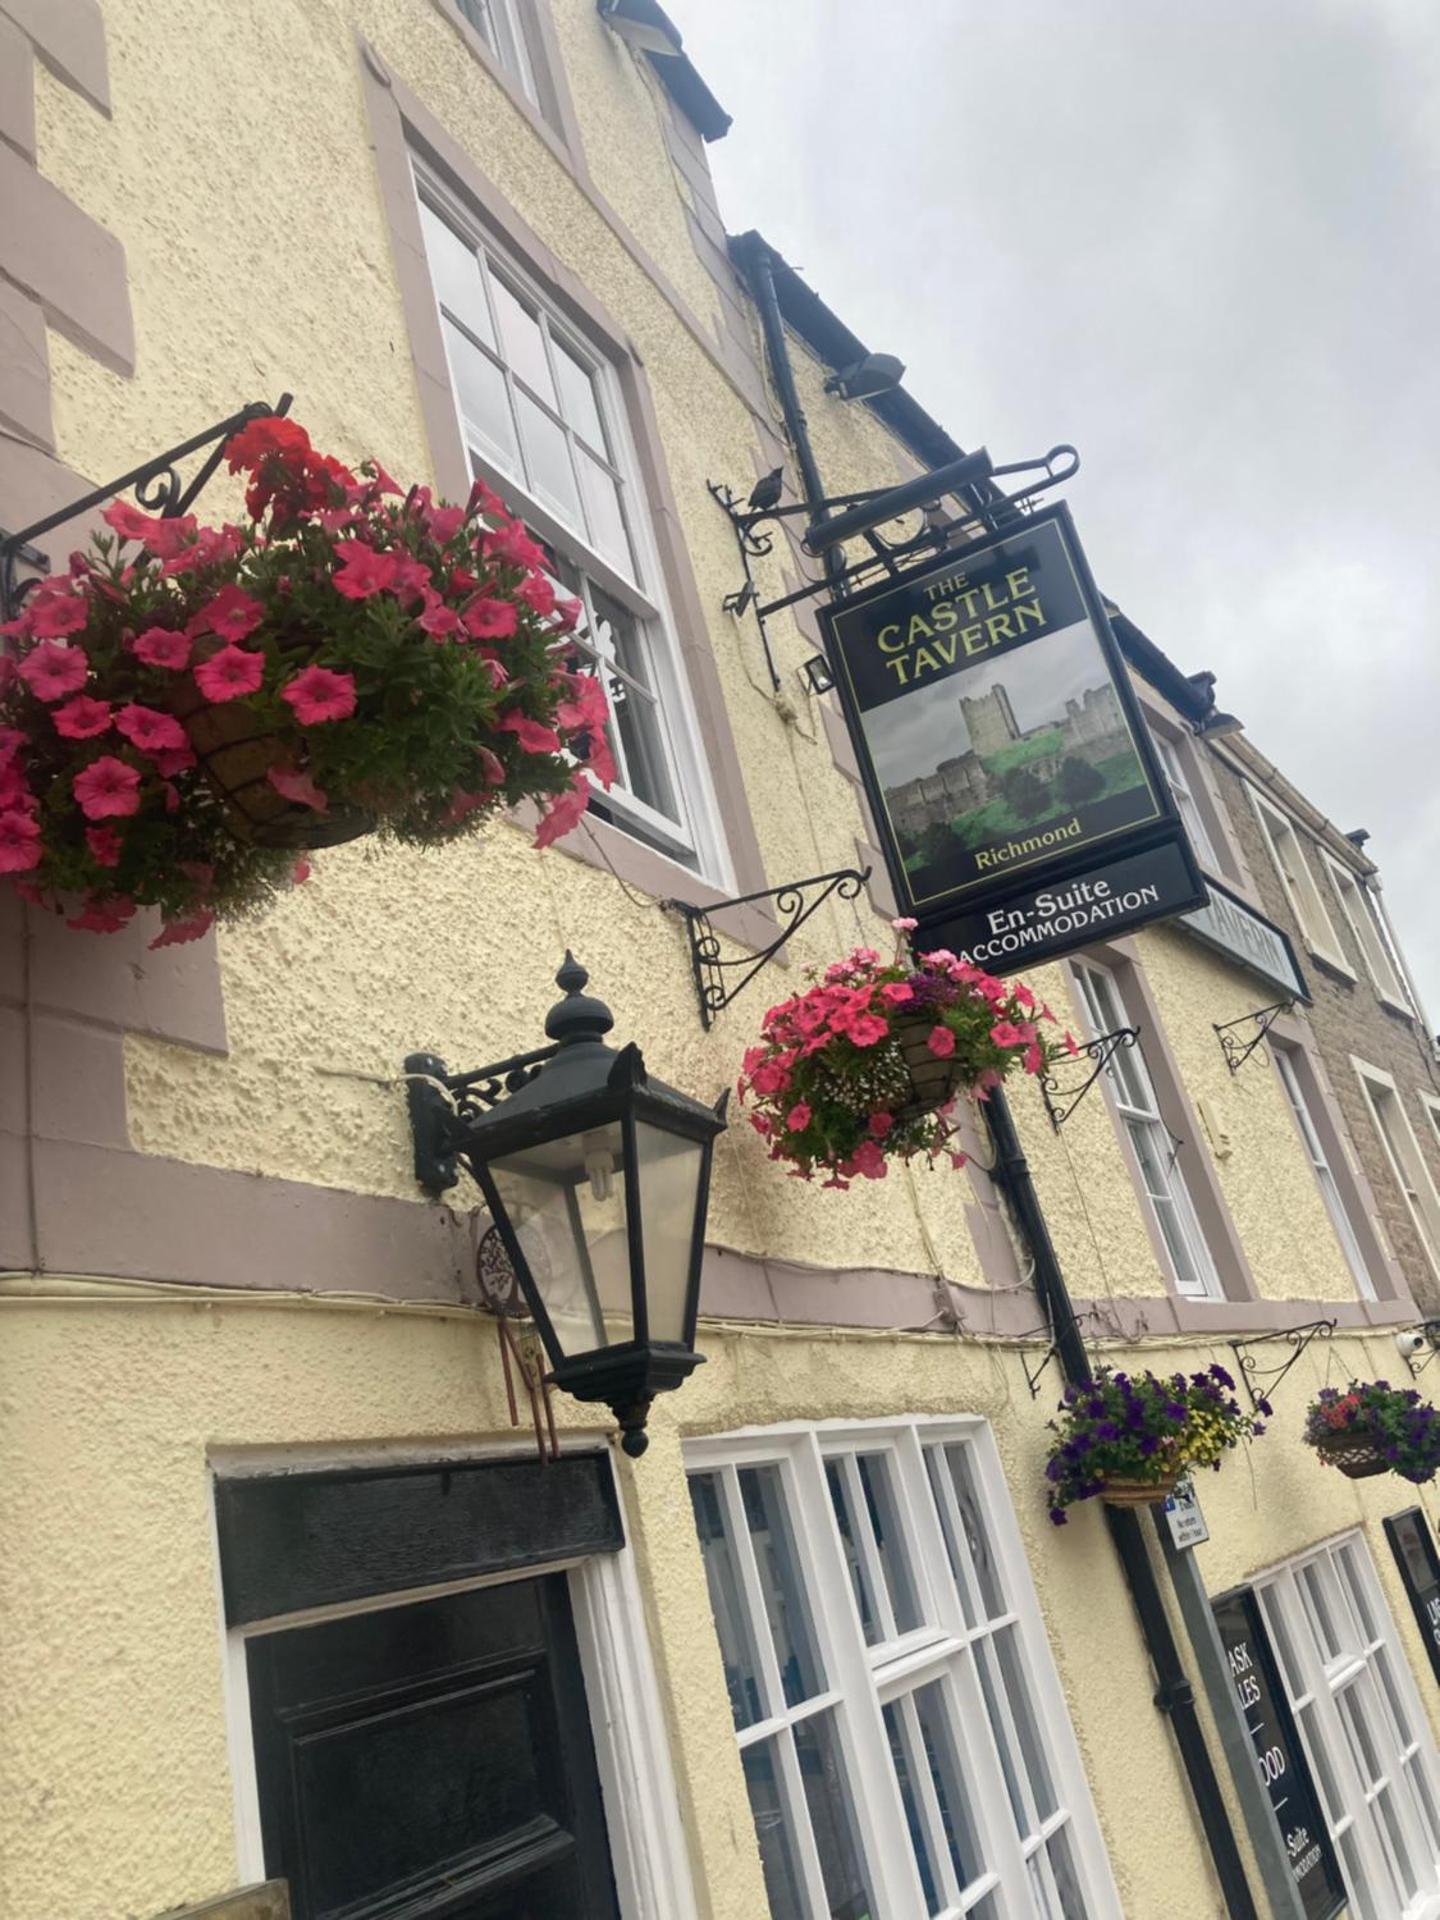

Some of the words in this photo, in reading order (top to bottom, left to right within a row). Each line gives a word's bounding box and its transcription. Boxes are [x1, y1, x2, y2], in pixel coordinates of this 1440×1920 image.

[877, 566, 1036, 653] CASTLE
[923, 571, 970, 601] THE
[885, 598, 1047, 685] TAVERN
[974, 817, 1082, 870] Richmond
[959, 884, 1160, 965] ACCOMMODATION
[986, 880, 1111, 935] En-Suite
[1228, 1642, 1253, 1678] ASK
[1258, 1746, 1285, 1786] OOD
